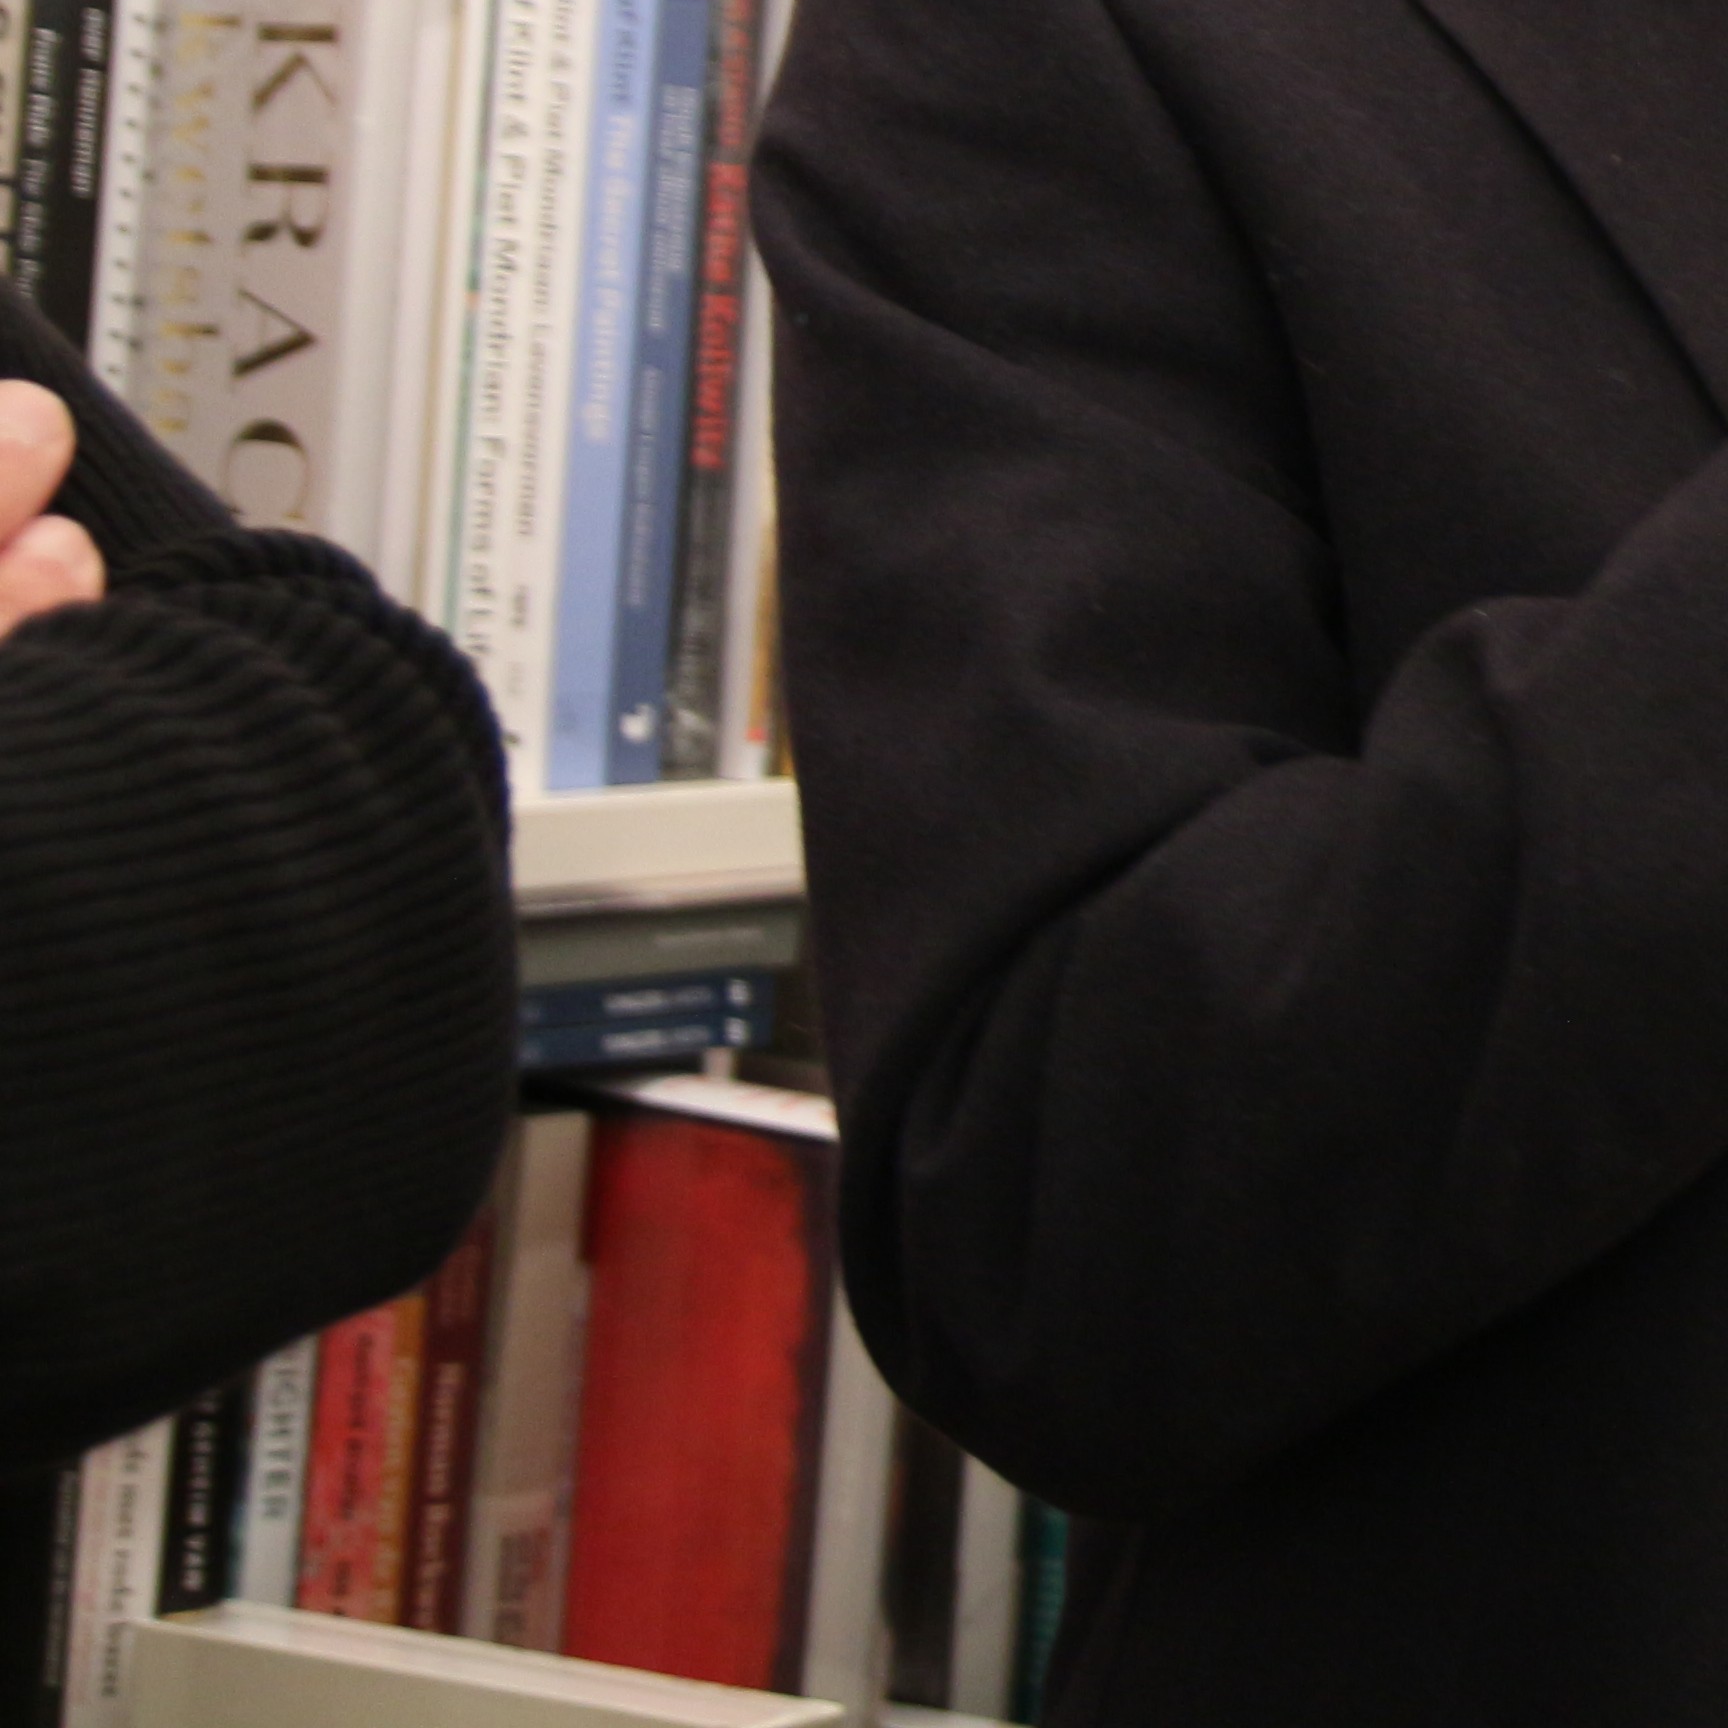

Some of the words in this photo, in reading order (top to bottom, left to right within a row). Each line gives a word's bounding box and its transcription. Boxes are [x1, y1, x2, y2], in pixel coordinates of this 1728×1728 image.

[506, 21, 536, 103] Klint
[550, 49, 573, 72] &
[612, 29, 642, 111] Klint
[501, 114, 529, 139] &
[546, 81, 570, 141] Piet
[605, 115, 633, 169] The
[498, 154, 528, 225] Piet
[599, 176, 631, 279] Secret
[581, 288, 622, 442] Paintings
[693, 294, 740, 468] Kollwitz
[474, 437, 506, 551] Forms
[470, 564, 500, 603] of
